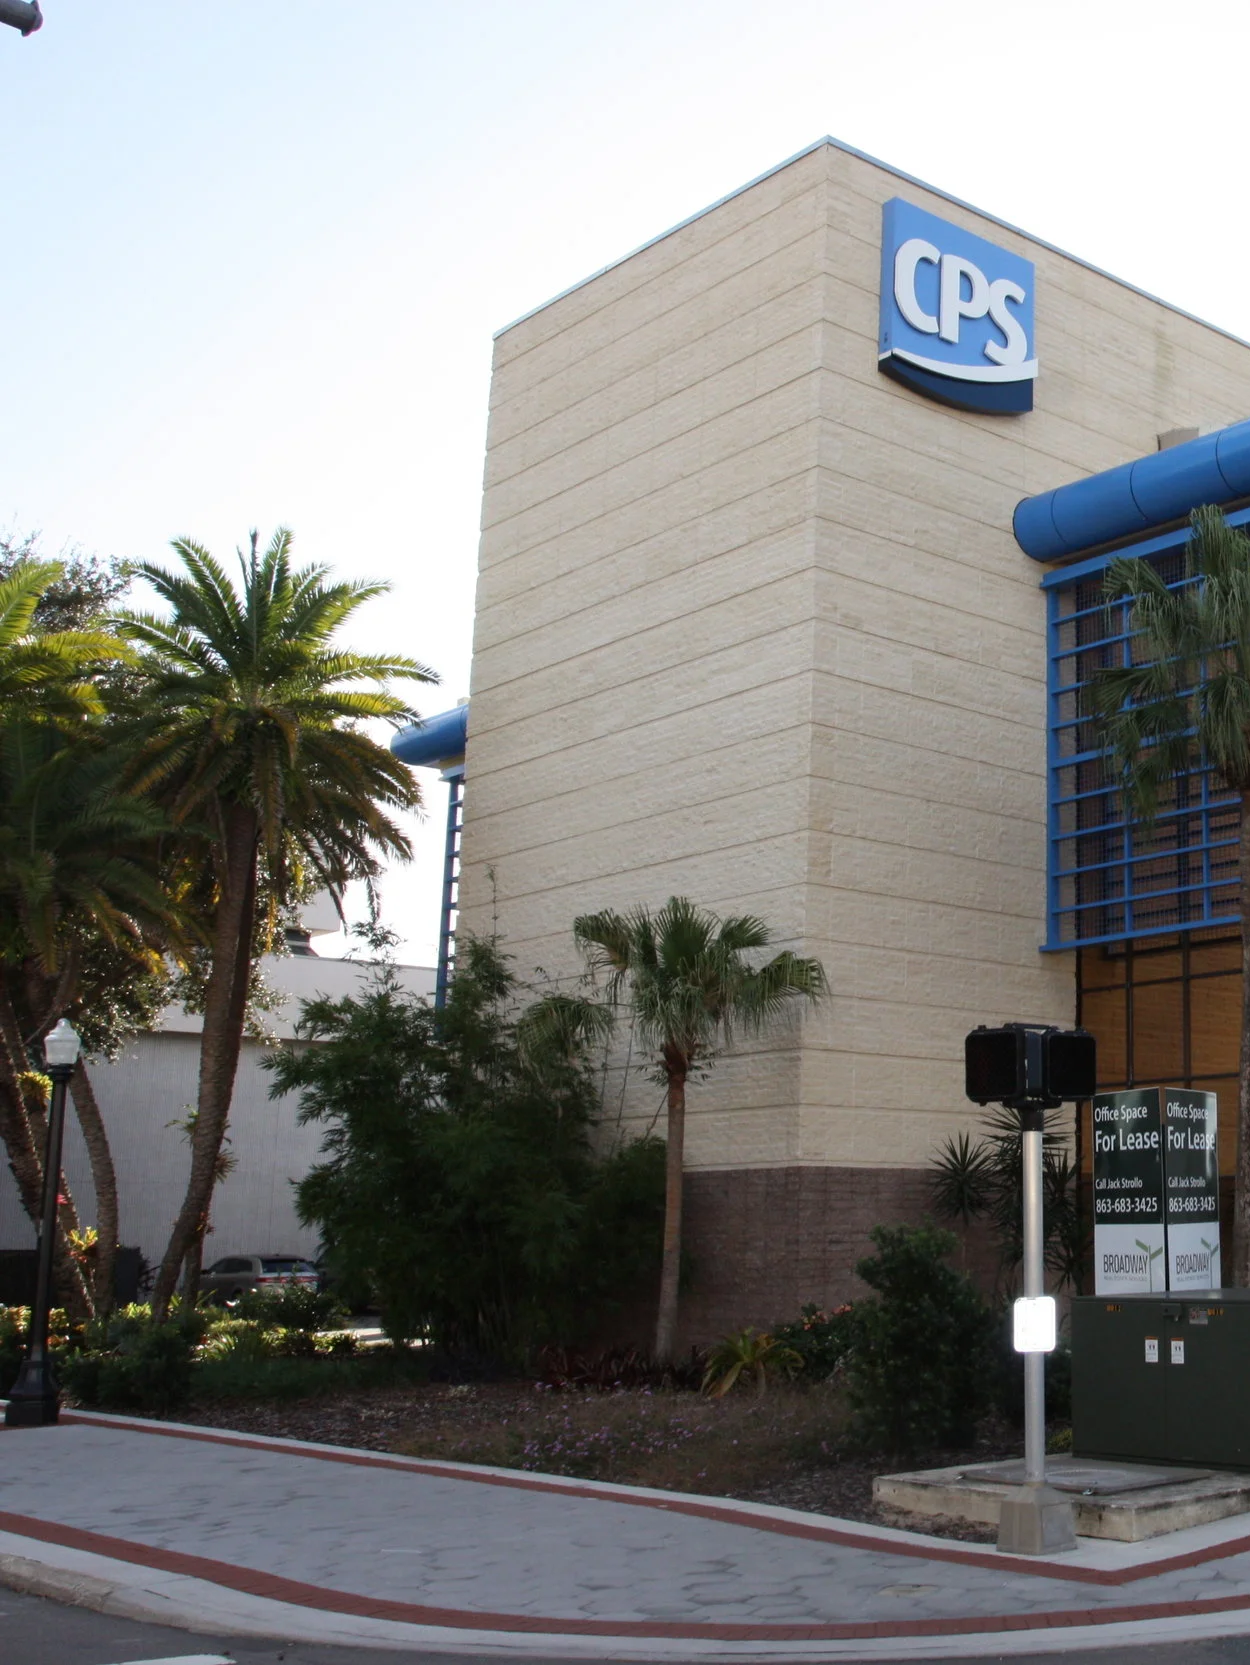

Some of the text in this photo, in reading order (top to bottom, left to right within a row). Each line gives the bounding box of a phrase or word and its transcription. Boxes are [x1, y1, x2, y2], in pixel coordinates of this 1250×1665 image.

[894, 238, 1028, 366] CPS
[1094, 1104, 1148, 1123] Office Space
[1166, 1102, 1209, 1123] Office Space
[1095, 1128, 1159, 1152] For Lease
[1167, 1126, 1215, 1152] For Lease
[1095, 1178, 1107, 1190] Call
[1107, 1178, 1121, 1189] Jack
[1168, 1177, 1178, 1188] Call
[1096, 1197, 1158, 1213] 863-683-3425
[1168, 1196, 1216, 1213] 863-683-3425
[1103, 1254, 1148, 1274] BROADWAY
[1176, 1253, 1210, 1275] BROADWAY
